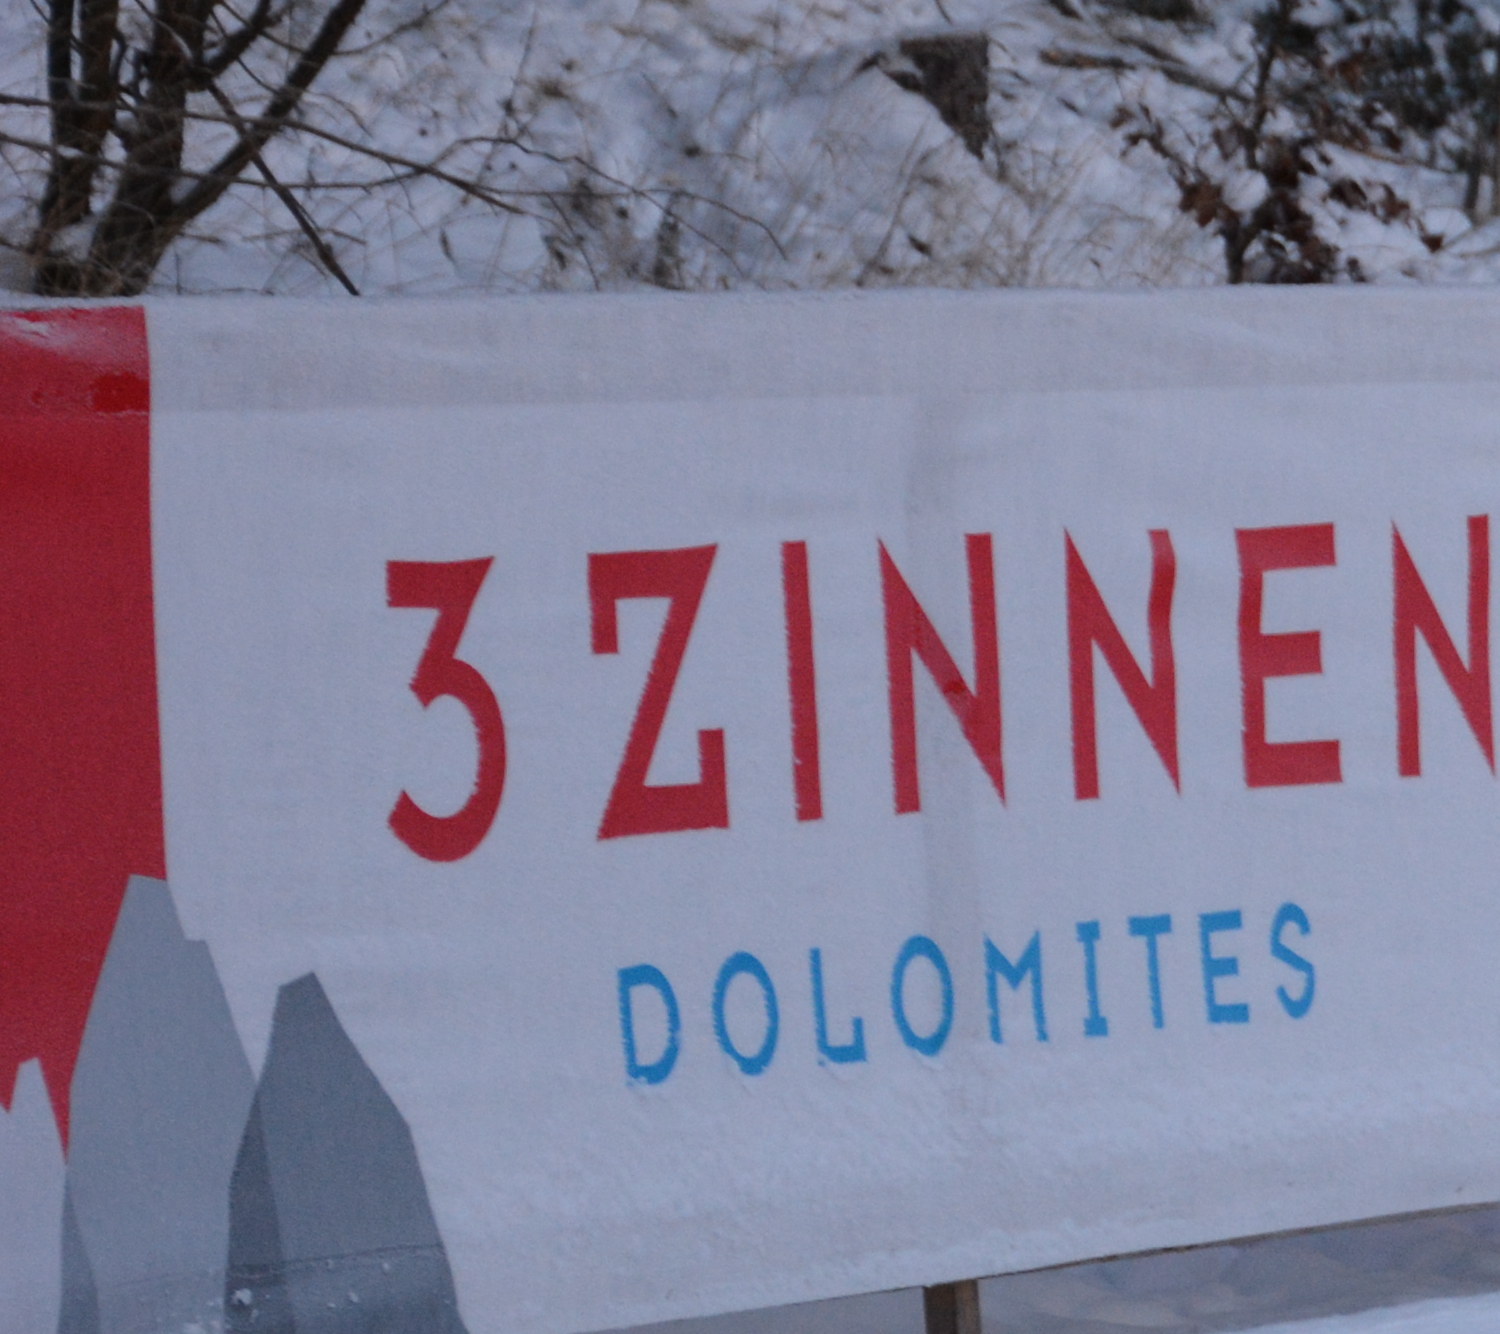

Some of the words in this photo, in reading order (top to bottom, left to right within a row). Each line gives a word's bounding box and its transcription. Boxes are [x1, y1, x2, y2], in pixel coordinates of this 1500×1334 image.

[386, 556, 507, 862] 3
[587, 514, 1496, 841] ZINNEN
[617, 902, 1317, 1085] DOLOMITES
